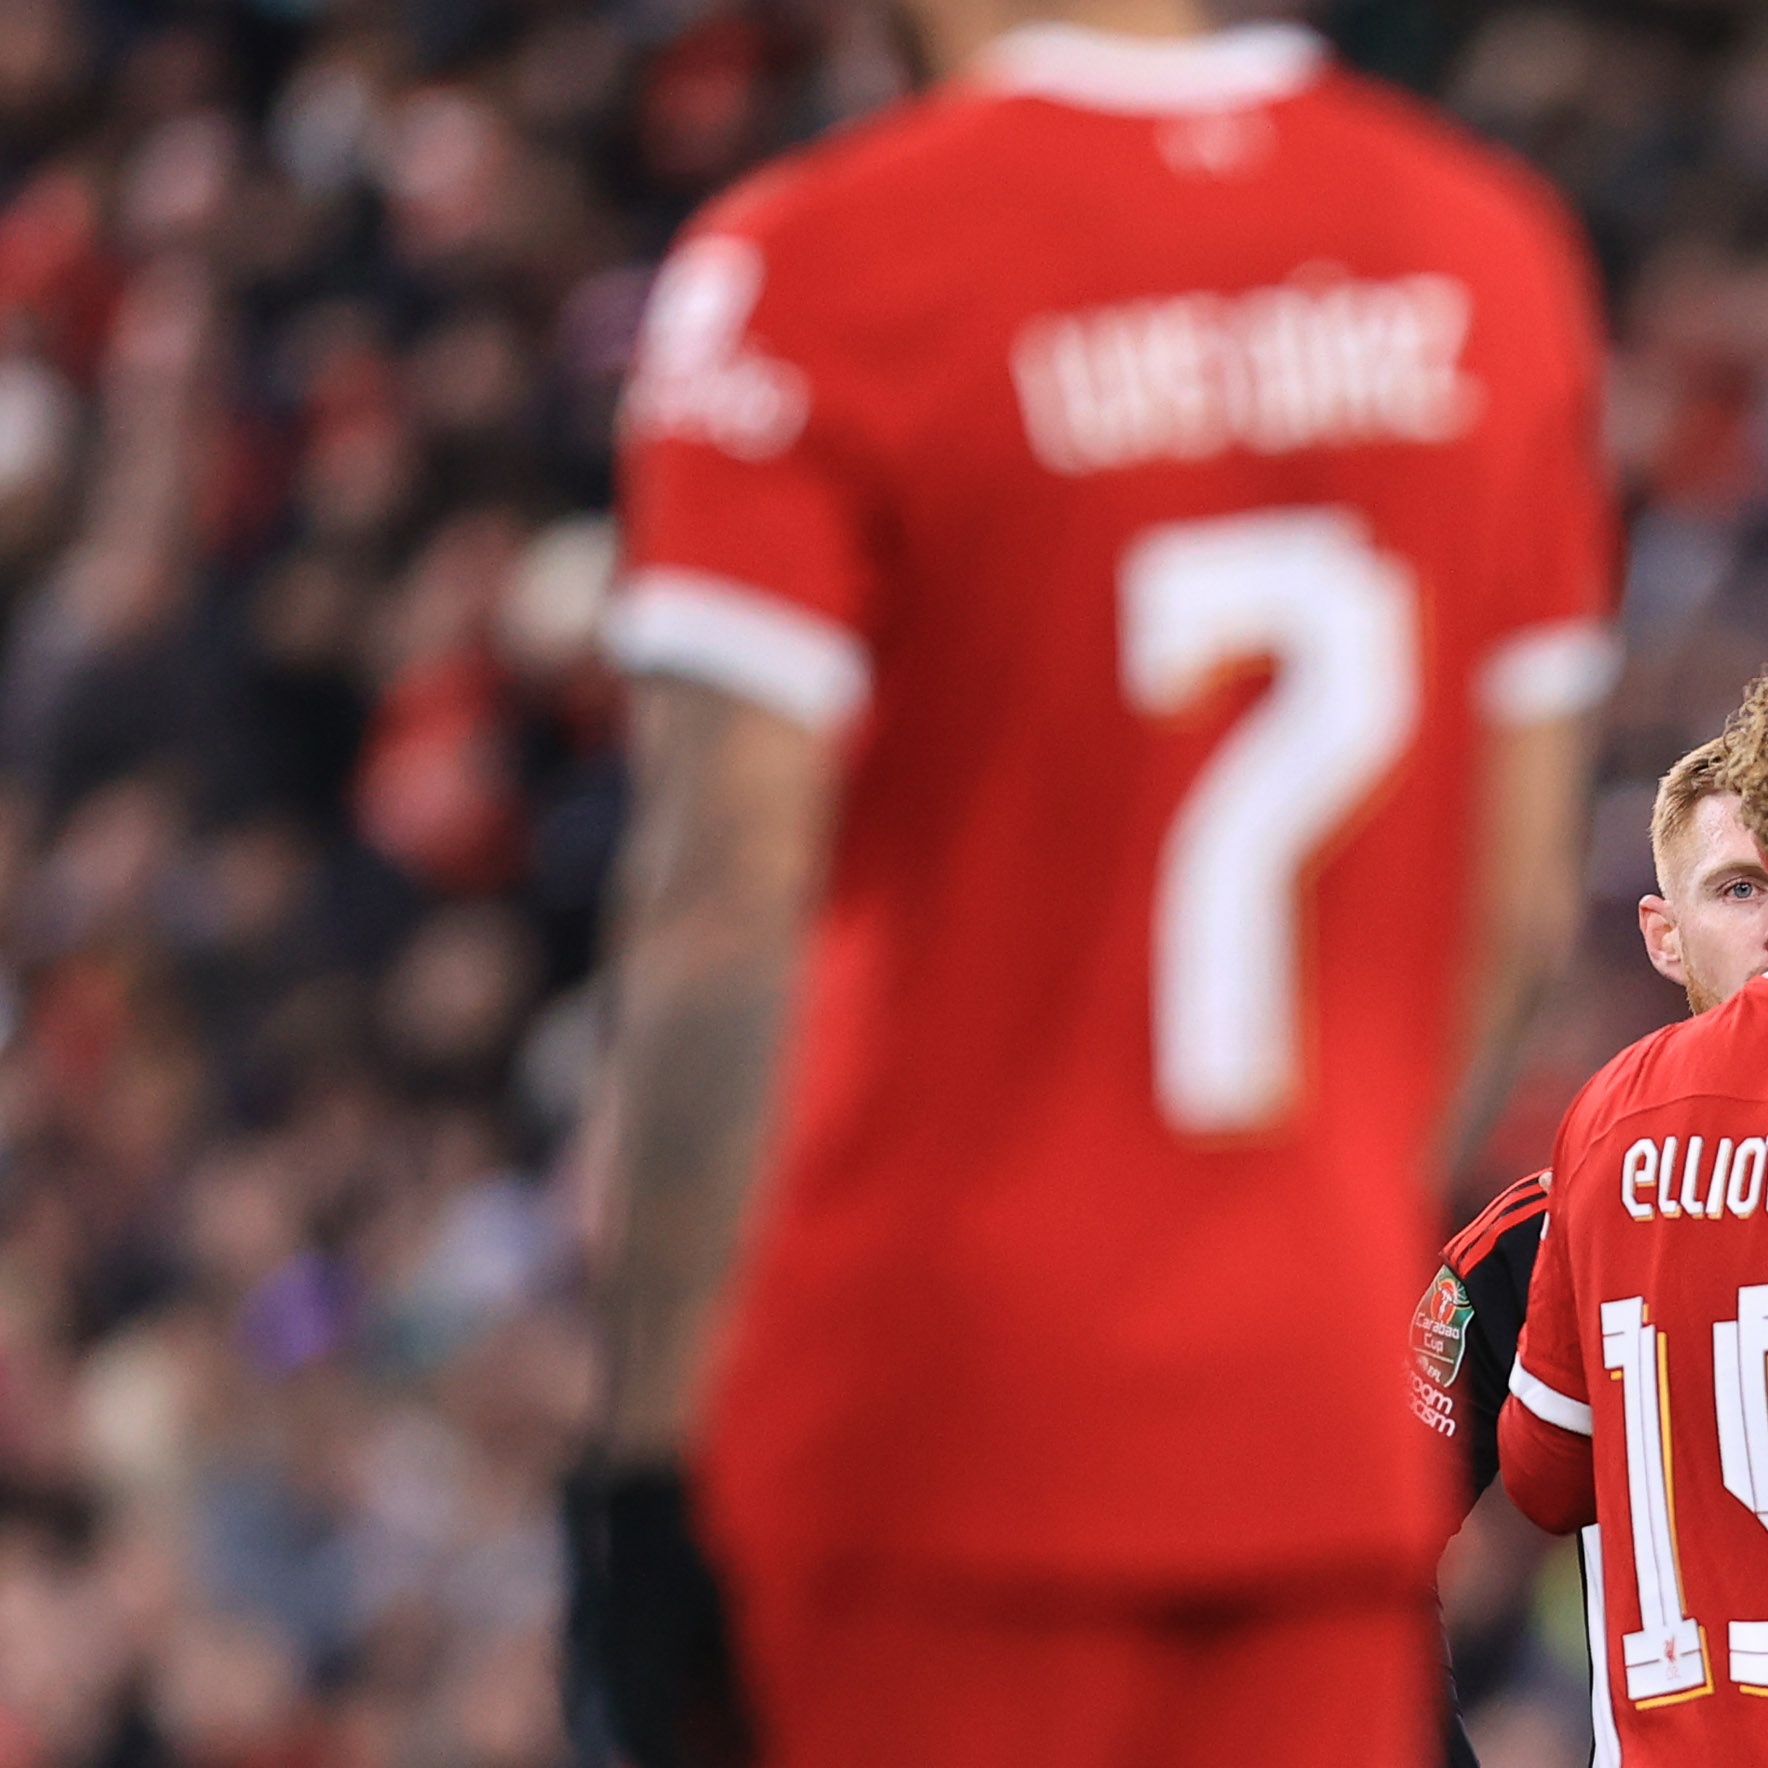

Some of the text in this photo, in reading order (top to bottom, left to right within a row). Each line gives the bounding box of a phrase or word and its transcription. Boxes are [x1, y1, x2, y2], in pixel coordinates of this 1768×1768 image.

[1112, 502, 1422, 1142] 7
[1415, 1311, 1461, 1341] Carabao
[1424, 1332, 1445, 1355] Cup
